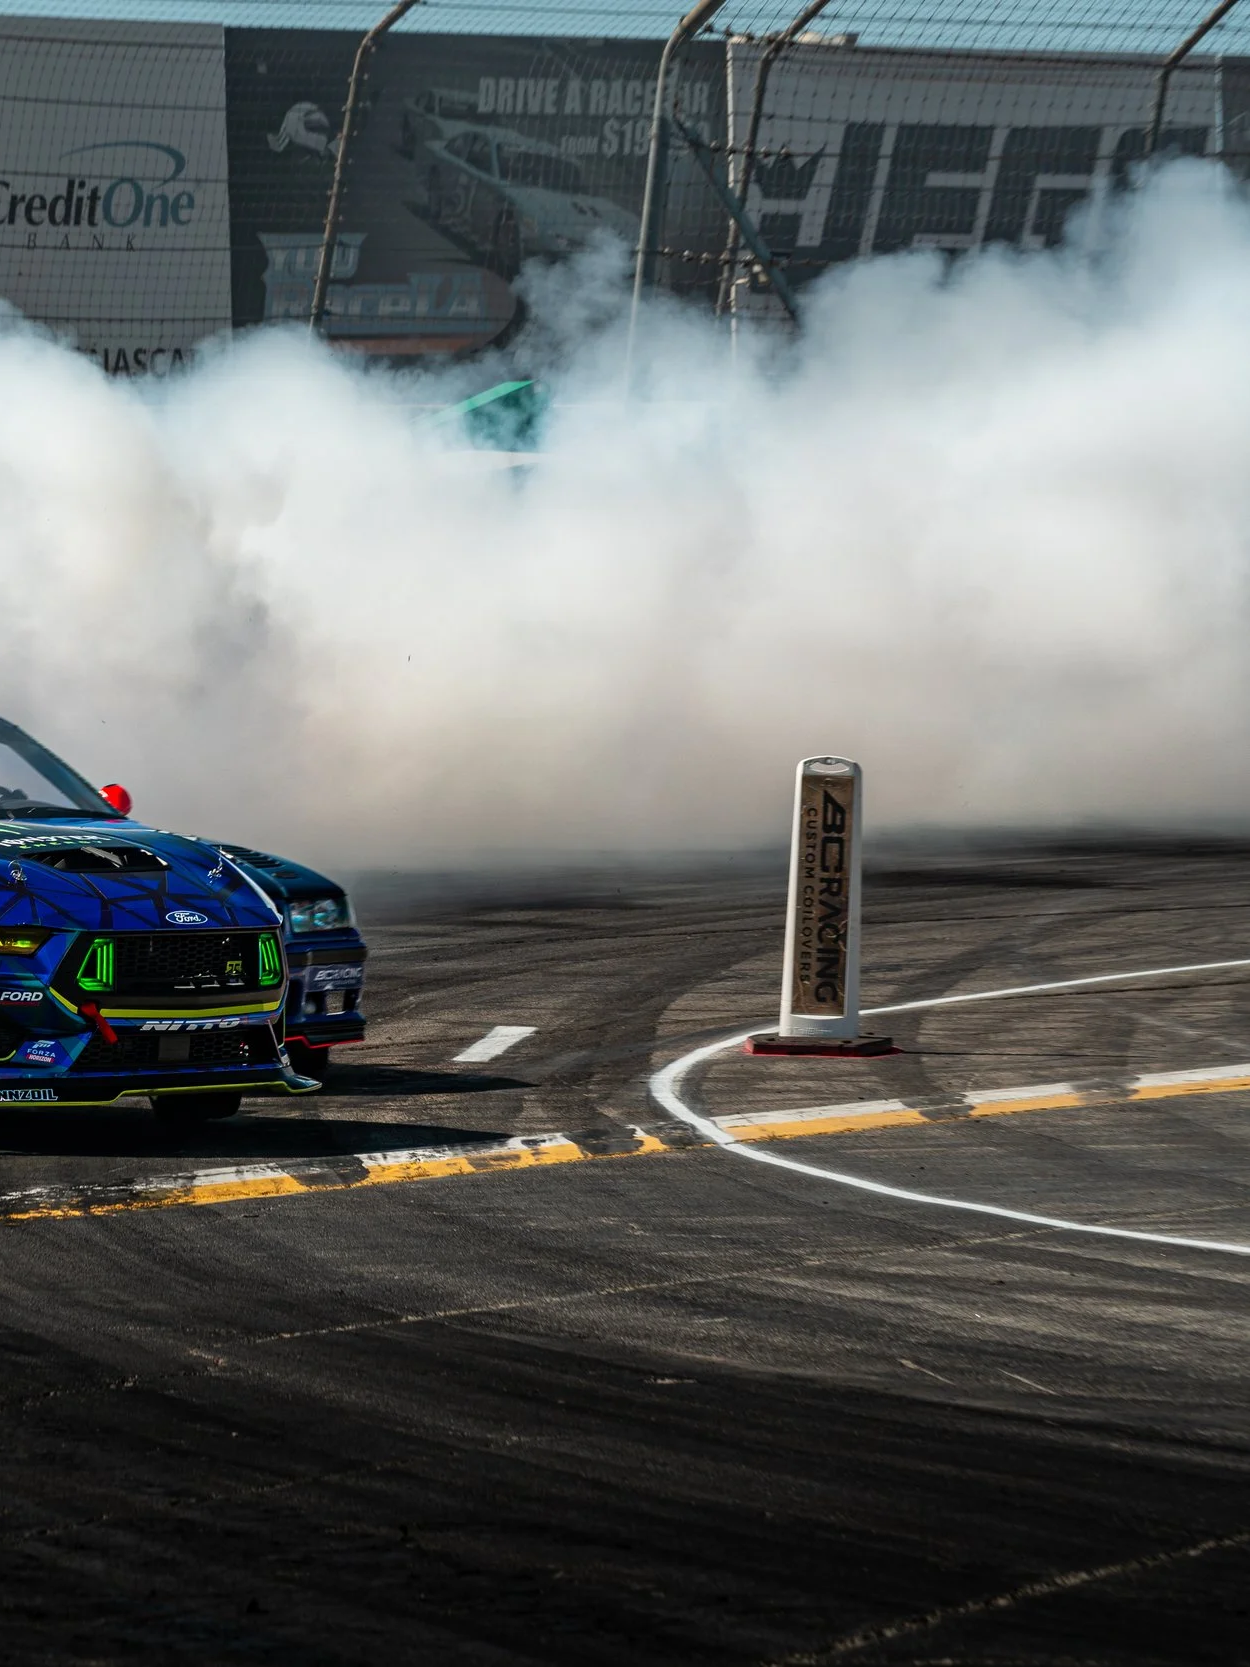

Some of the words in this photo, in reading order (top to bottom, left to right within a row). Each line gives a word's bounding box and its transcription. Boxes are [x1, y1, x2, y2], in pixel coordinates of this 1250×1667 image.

[477, 77, 559, 115] DRIVE
[563, 78, 582, 115] A
[588, 79, 657, 117] RACE
[561, 136, 599, 154] FROM
[26, 231, 137, 252] BANK
[805, 807, 818, 879] CUSTOM
[174, 911, 202, 923] Ford
[799, 885, 815, 983] COILOVERS
[0, 991, 43, 1001] FORD
[140, 1018, 240, 1031] NITTO
[27, 1048, 56, 1058] FORZA
[29, 1054, 52, 1063] HORIZON
